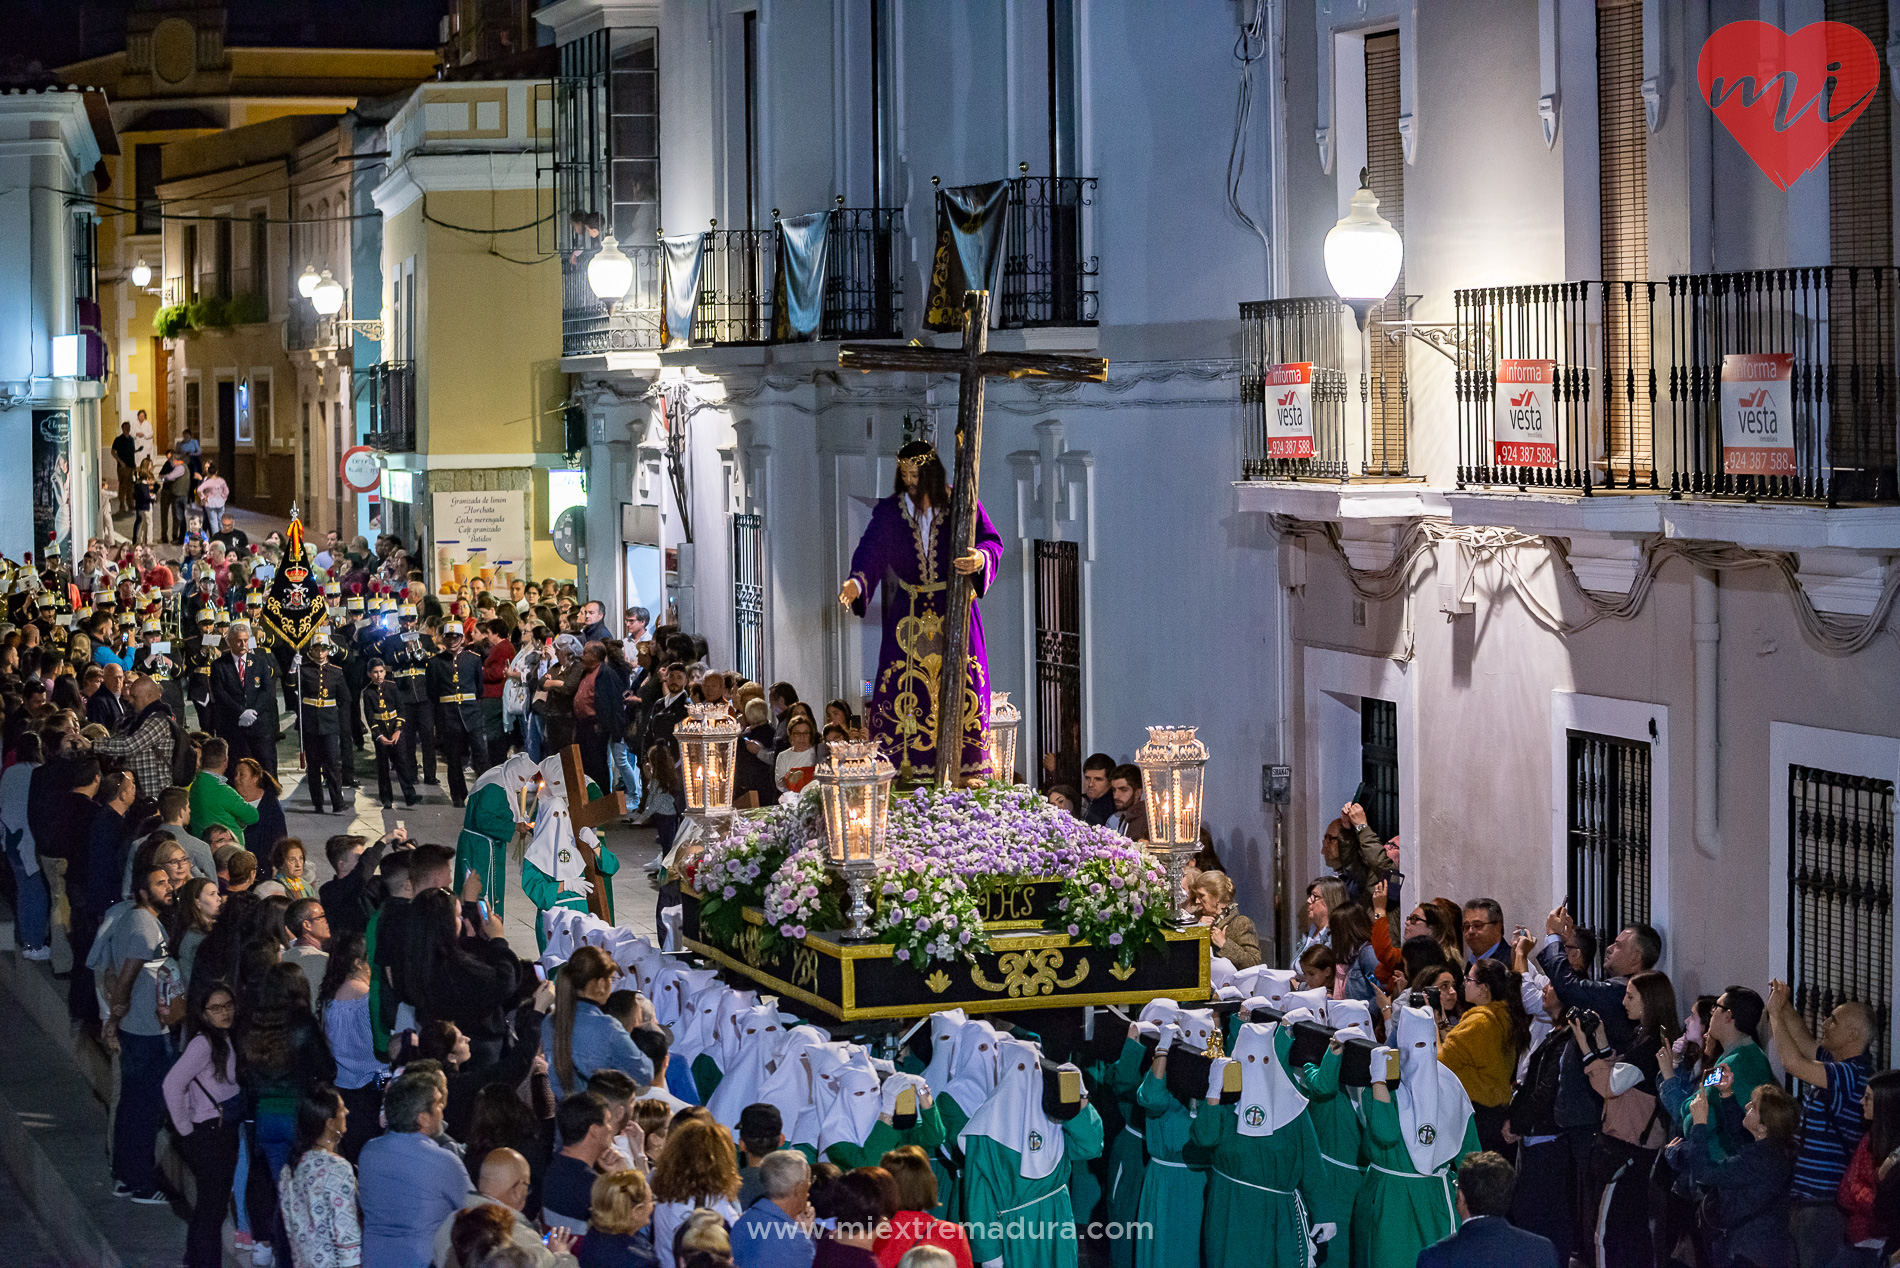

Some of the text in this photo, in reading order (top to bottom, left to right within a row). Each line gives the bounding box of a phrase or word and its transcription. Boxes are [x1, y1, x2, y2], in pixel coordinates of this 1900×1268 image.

[1272, 366, 1302, 384] informa
[1506, 361, 1542, 382] informa
[1277, 404, 1303, 427] vesta
[1509, 405, 1543, 431] vesta
[1738, 406, 1778, 434] vesta
[1272, 439, 1311, 455] 924 387 588
[1501, 445, 1552, 464] 924 387 588
[1730, 451, 1789, 470] 924 387 588
[482, 496, 489, 504] de
[464, 505, 495, 514] Horchata
[454, 515, 505, 525] Leche merengada
[473, 525, 502, 533] granizado
[468, 534, 492, 543] Batidos
